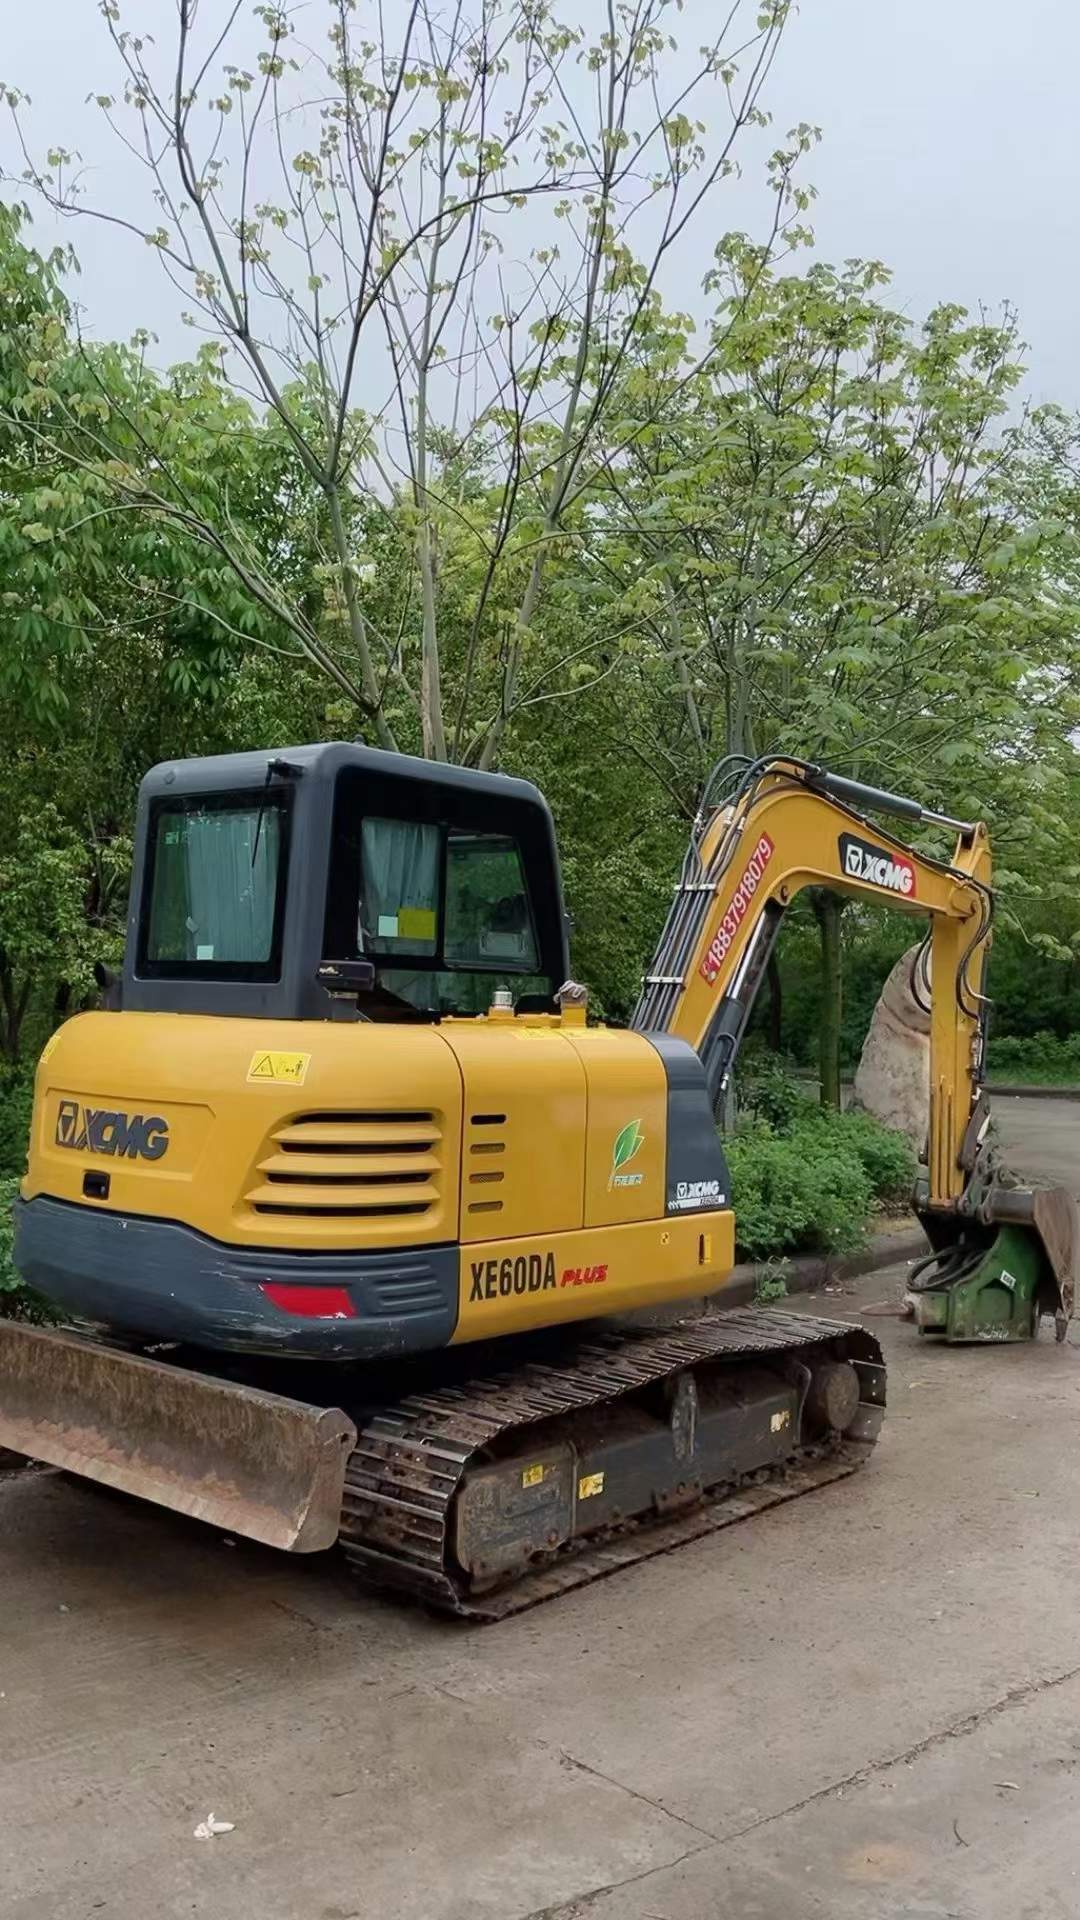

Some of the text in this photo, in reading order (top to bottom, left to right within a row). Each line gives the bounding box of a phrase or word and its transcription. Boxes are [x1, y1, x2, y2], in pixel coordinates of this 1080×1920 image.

[861, 853, 913, 894] XCMG
[707, 838, 772, 968] 18837918079
[76, 1107, 169, 1161] XCMG
[687, 1180, 720, 1198] XCMG
[469, 1252, 609, 1302] XE60DA PLUS
